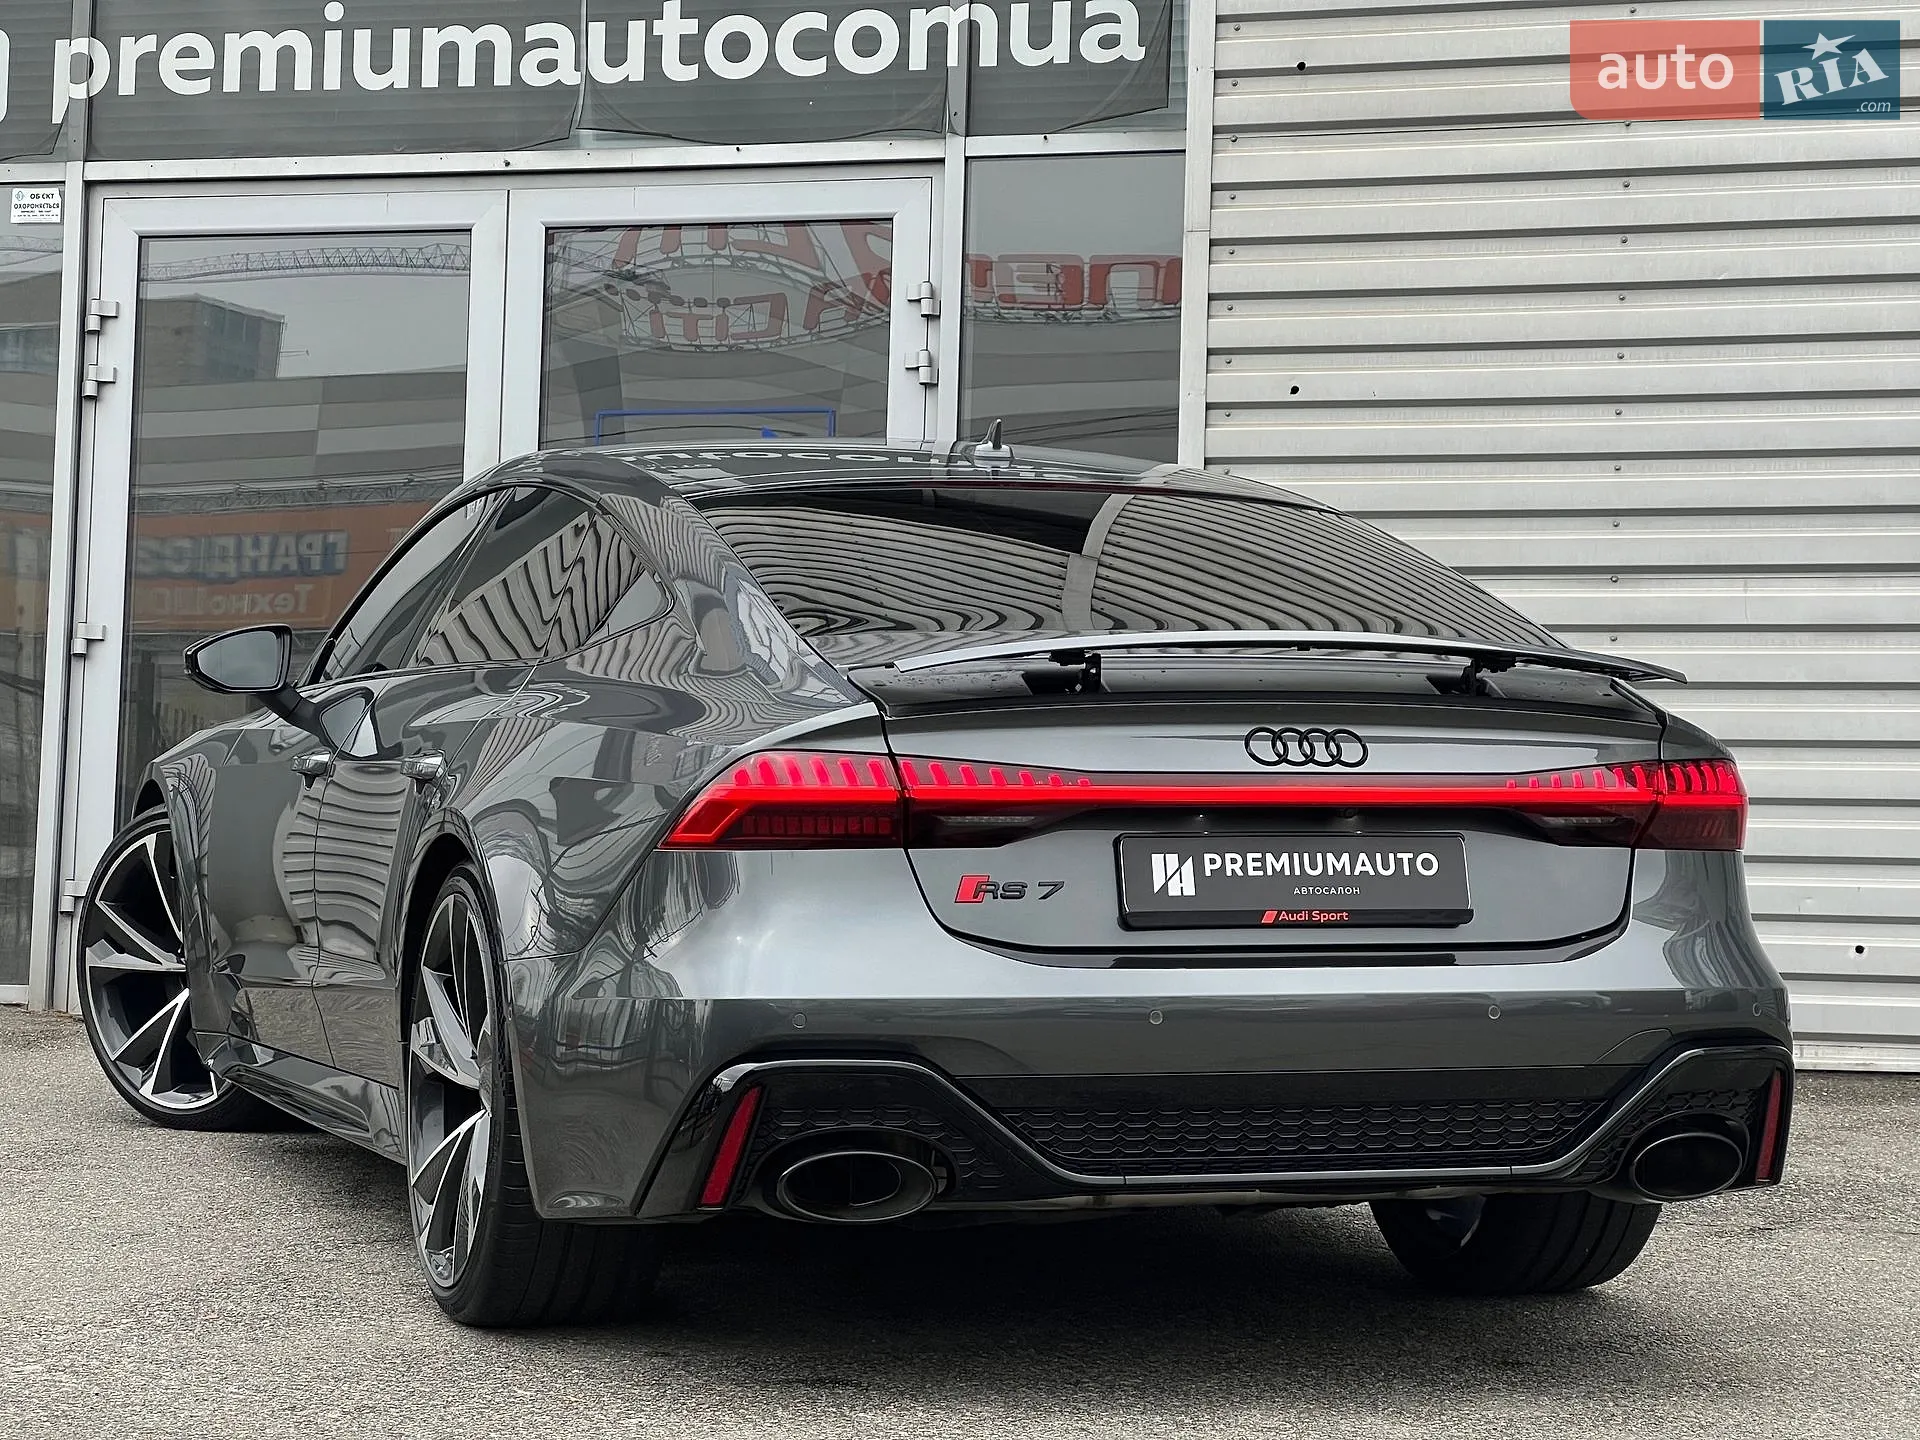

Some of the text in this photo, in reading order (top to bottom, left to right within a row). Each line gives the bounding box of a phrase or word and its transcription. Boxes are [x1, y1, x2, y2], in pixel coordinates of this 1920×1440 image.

[1203, 851, 1440, 877] PREMIUMAUTO
[972, 880, 1066, 900] RS 7
[1292, 885, 1361, 896] АВТОСАЛОН
[1278, 910, 1350, 923] Audi Sport
